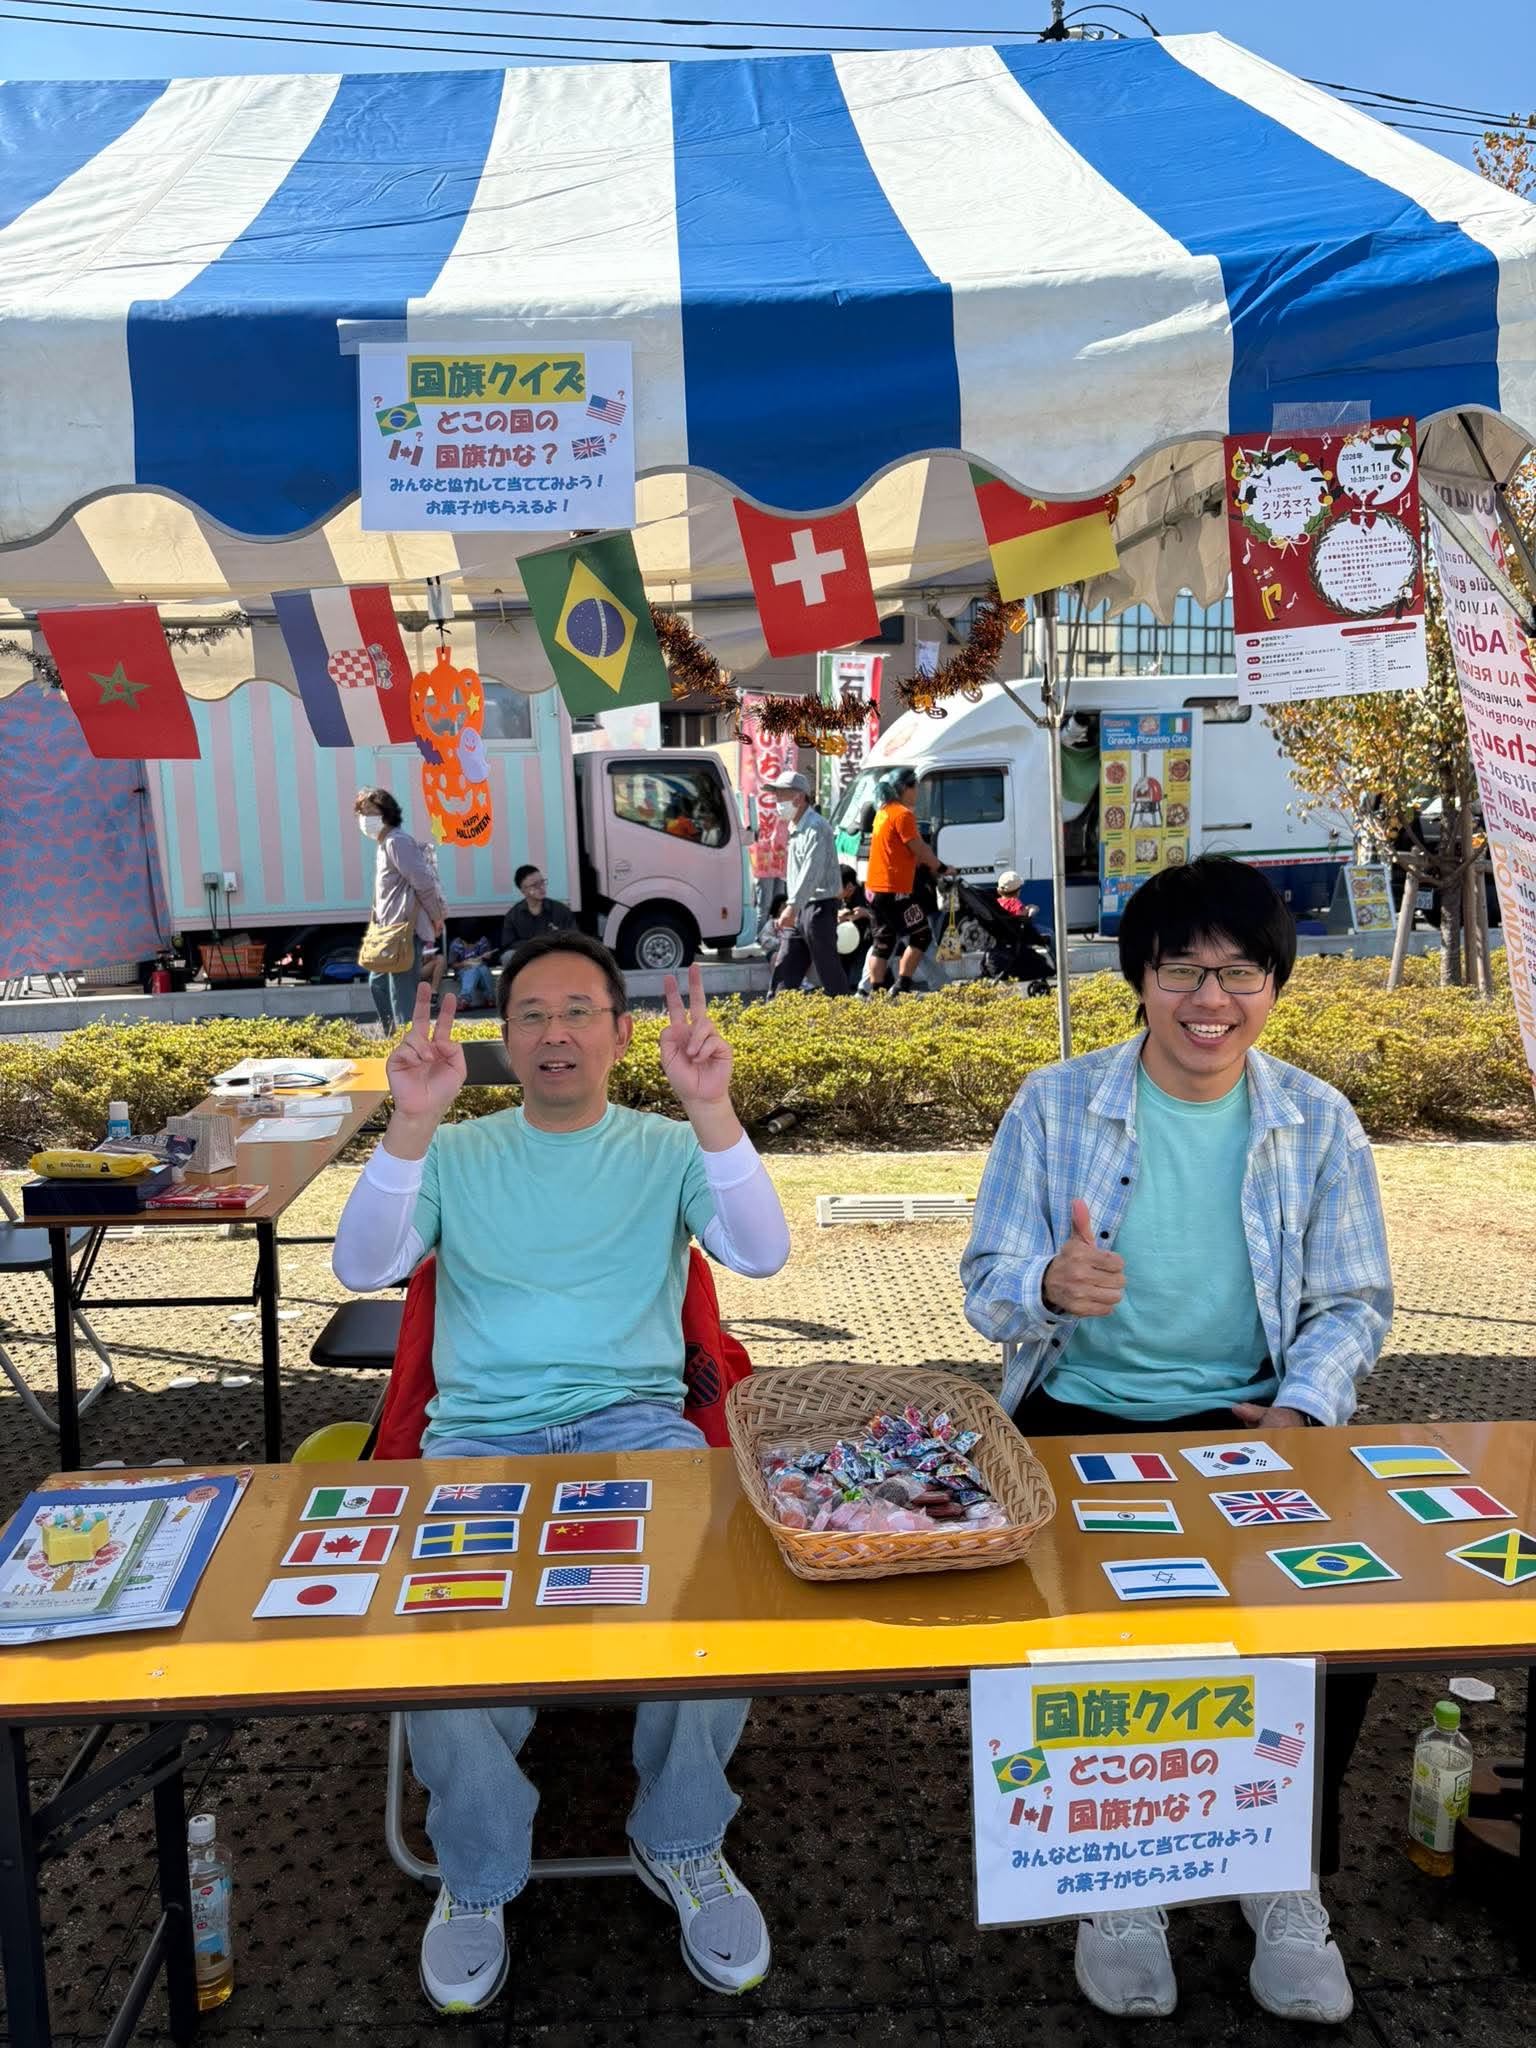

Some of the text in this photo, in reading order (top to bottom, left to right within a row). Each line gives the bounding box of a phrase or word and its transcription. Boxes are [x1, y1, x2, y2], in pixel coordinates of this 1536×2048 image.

[410, 361, 586, 398] 国旗クイズ
[436, 409, 559, 434] どこの国の
[436, 443, 558, 469] 国旗かな？
[389, 475, 603, 493] みんなと協力して当ててみよう！
[426, 499, 569, 516] お菓子がもらえるよ！
[1262, 497, 1312, 511] クリスマス
[1263, 507, 1312, 520] コンサート
[456, 813, 491, 839] HALLOWEEN
[1036, 1684, 1255, 1741] 国旗クイズ
[1069, 1748, 1219, 1786] どこの国の
[1068, 1789, 1217, 1834] 国旗かな？
[1012, 1827, 1272, 1869] みんなと協力して当ててみよう！
[1056, 1858, 1228, 1895] お菓子がもらえるよ！
